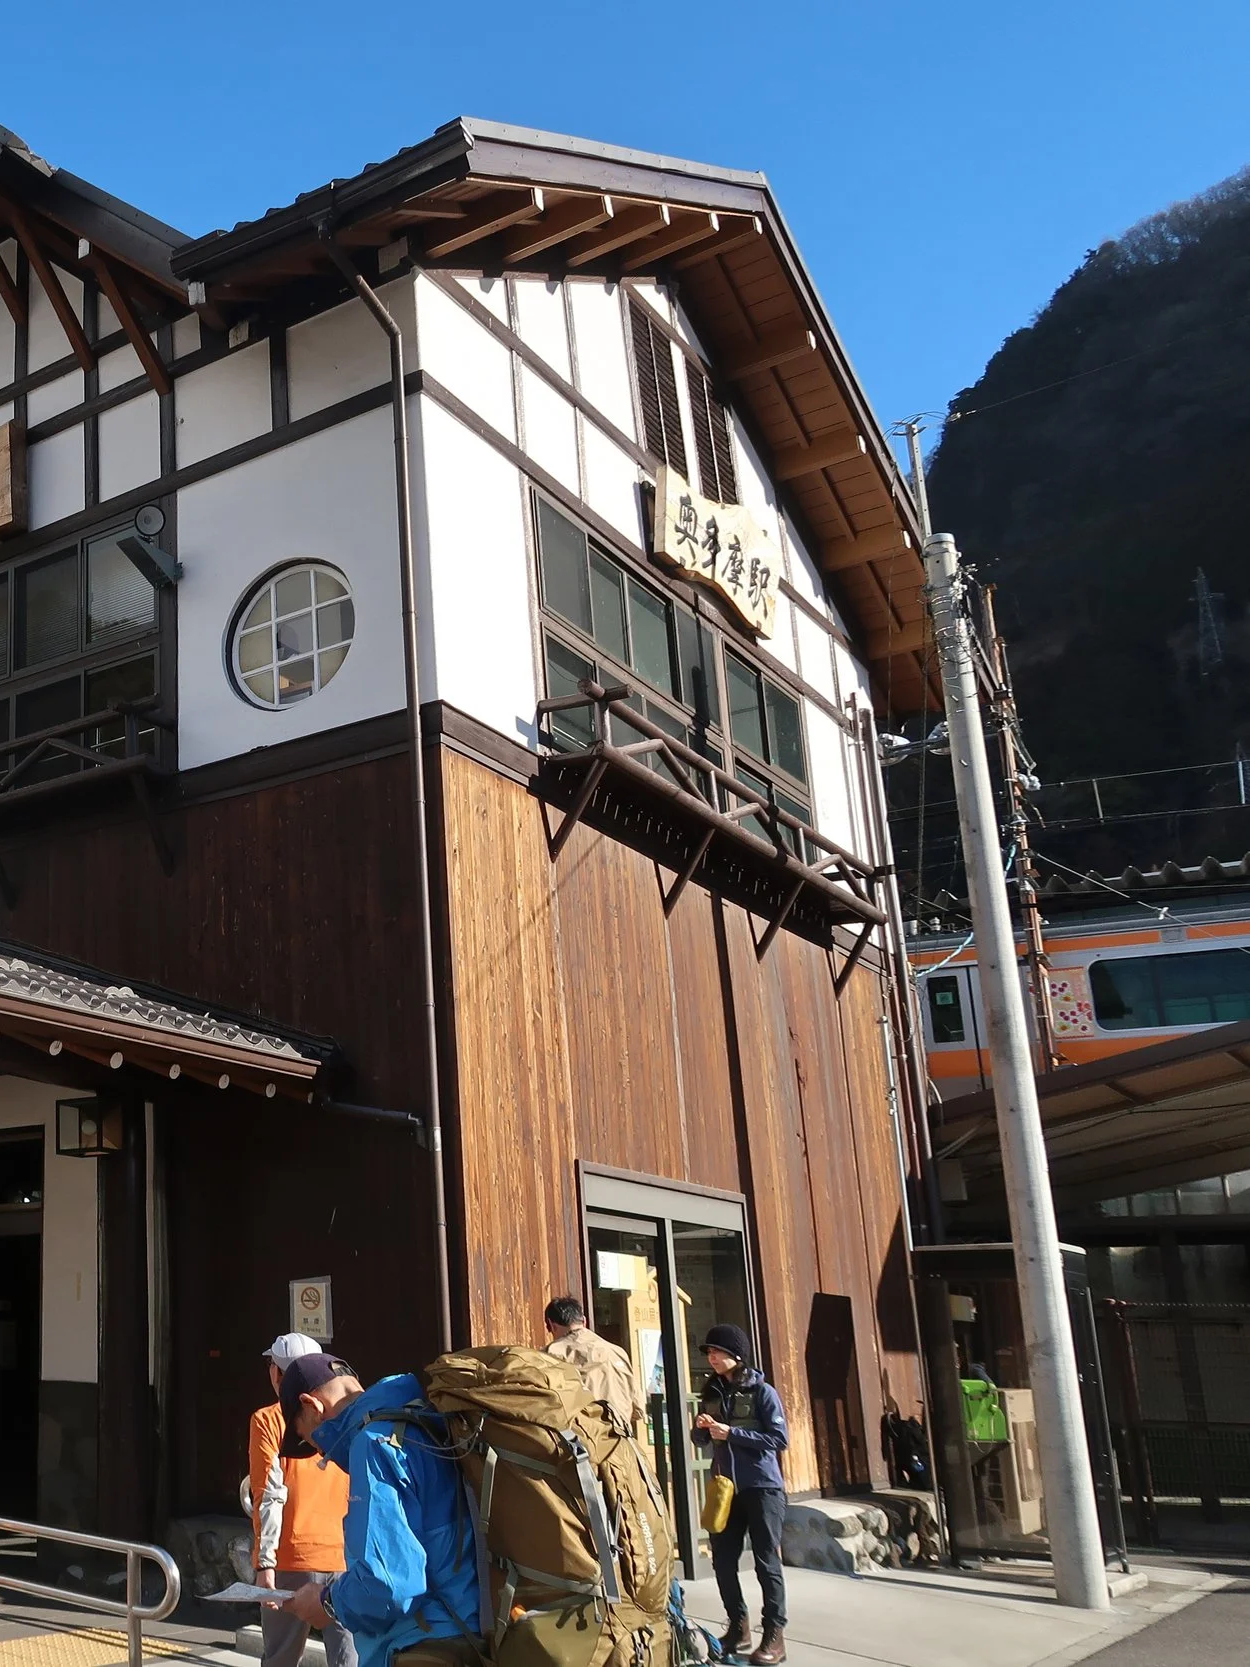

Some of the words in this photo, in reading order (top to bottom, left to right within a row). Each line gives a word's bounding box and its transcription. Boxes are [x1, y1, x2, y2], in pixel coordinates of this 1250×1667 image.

[675, 492, 771, 619] 奥多摩駅
[639, 1512, 655, 1555] EURASIA
